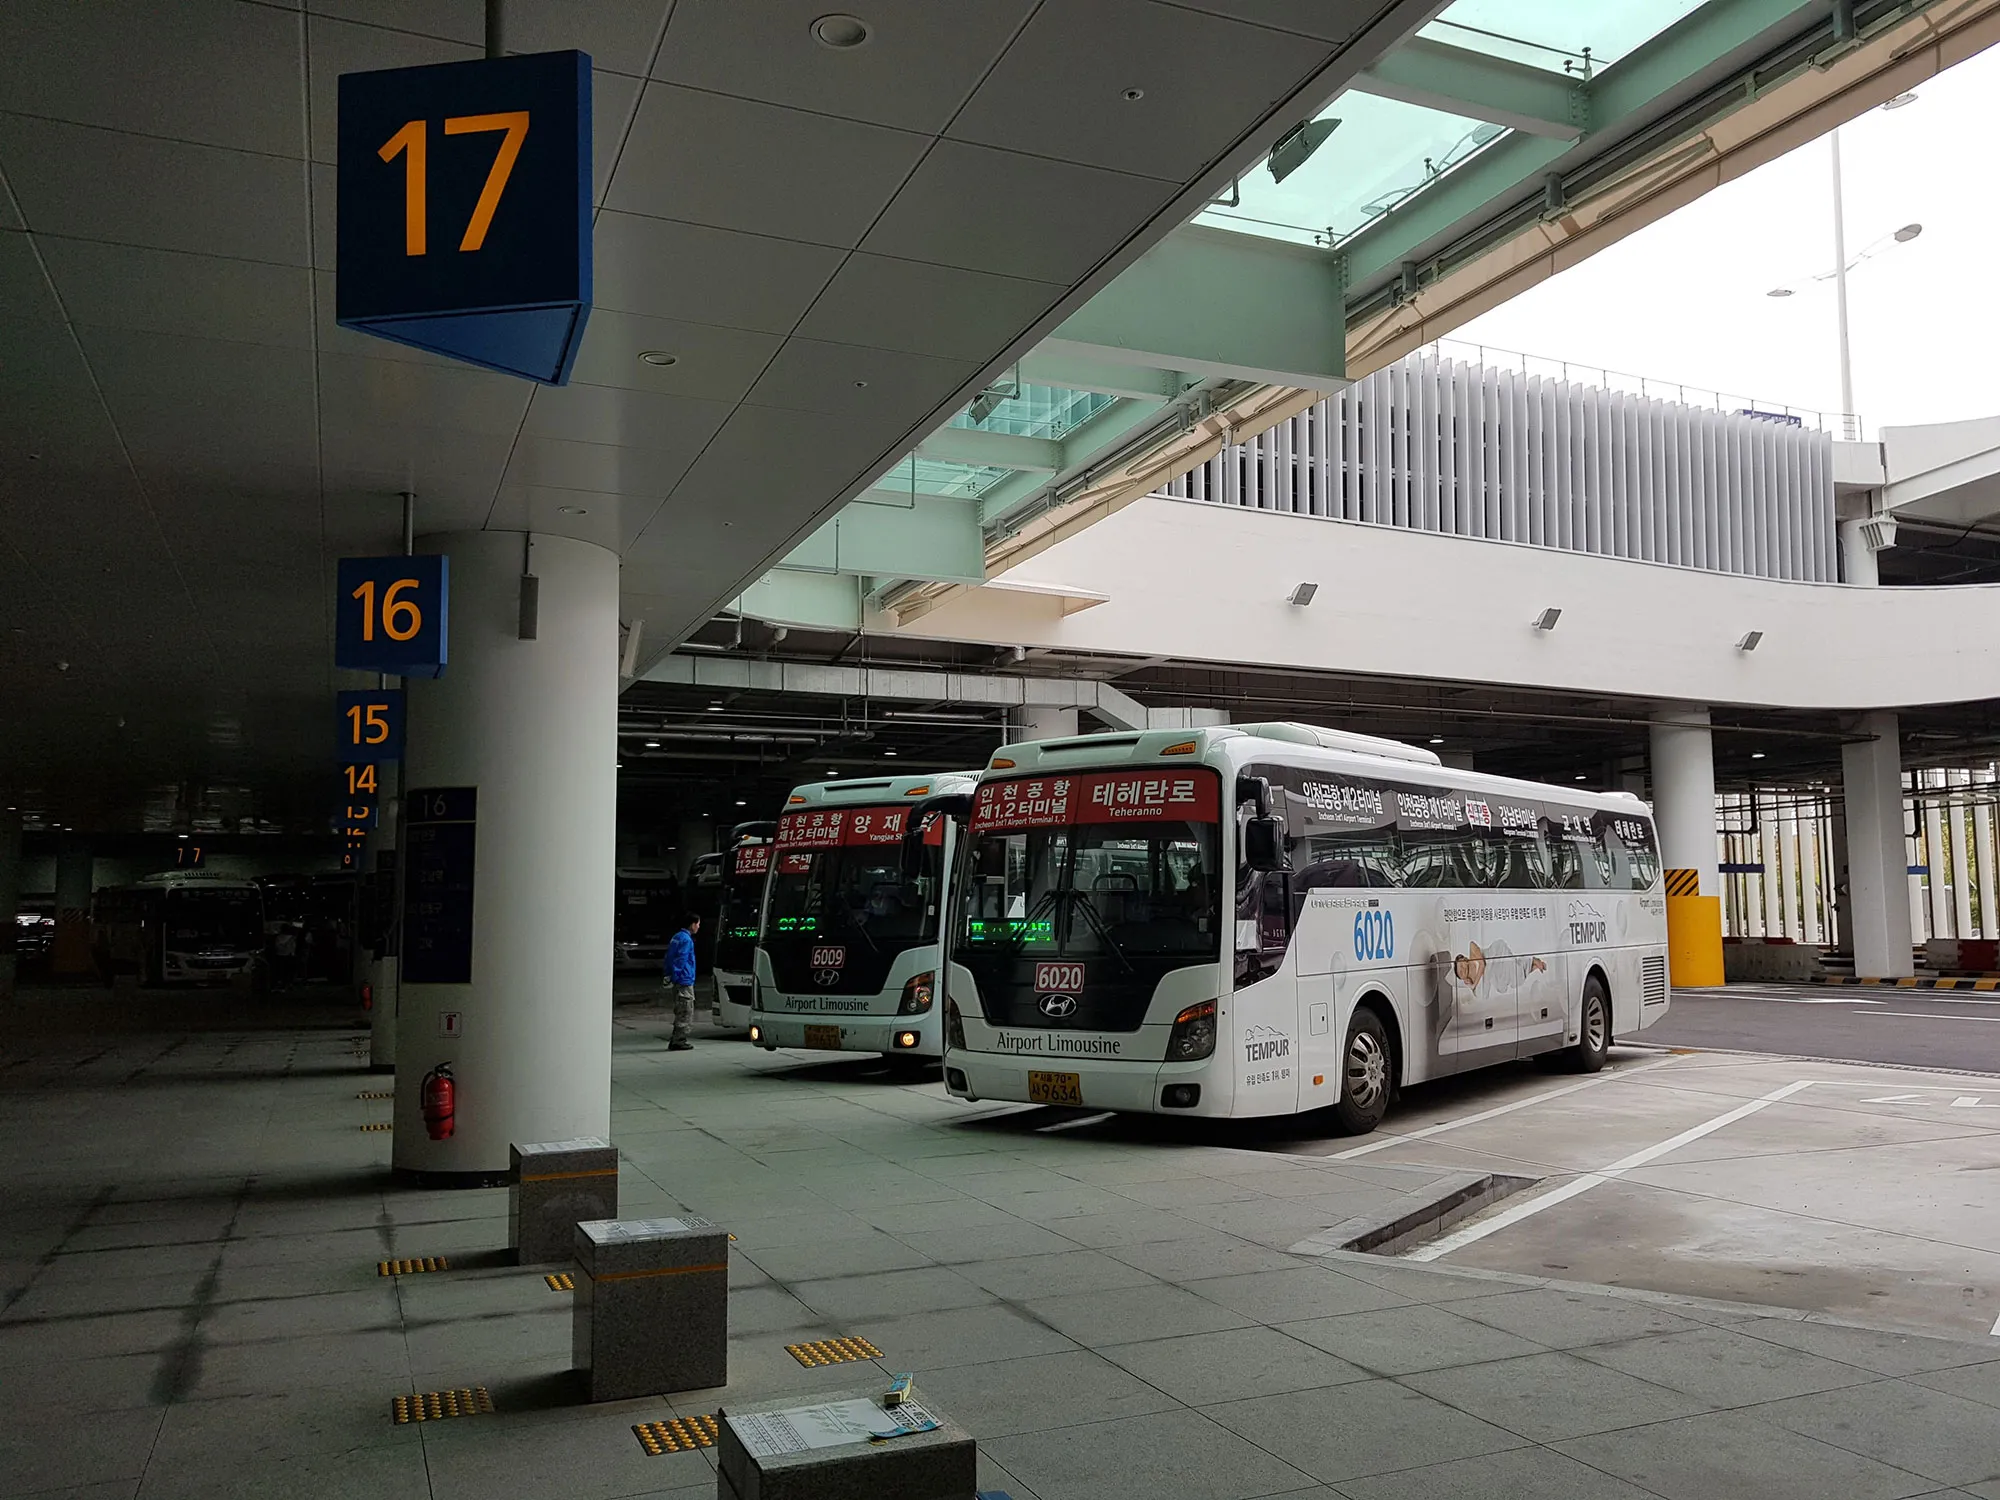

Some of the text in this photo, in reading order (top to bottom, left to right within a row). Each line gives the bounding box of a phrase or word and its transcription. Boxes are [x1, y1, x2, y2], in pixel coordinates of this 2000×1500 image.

[376, 110, 530, 257] 17
[352, 578, 422, 641] 16
[346, 704, 389, 745] 15
[344, 765, 378, 794] 14
[981, 780, 1071, 803] 인천공항
[1092, 779, 1196, 806] 테헤란로
[1303, 782, 1343, 811] 인천공항
[422, 793, 448, 819] 16
[1109, 807, 1163, 817] Teheranno
[1397, 793, 1430, 819] 인천공항
[781, 813, 843, 829] 인천공항
[1008, 818, 1027, 827] Airport
[1028, 816, 1054, 825] Terminal
[1614, 819, 1645, 840] 테헤란로
[870, 834, 894, 842] Yangjae
[1354, 910, 1394, 961] 6020
[1570, 922, 1607, 945] TEMPUR
[814, 949, 843, 965] 6009
[1038, 966, 1081, 989] 6020
[785, 996, 869, 1012] Airport Limousine
[997, 1031, 1121, 1054] Airport Limousine
[1245, 1038, 1290, 1062] TEMPUR
